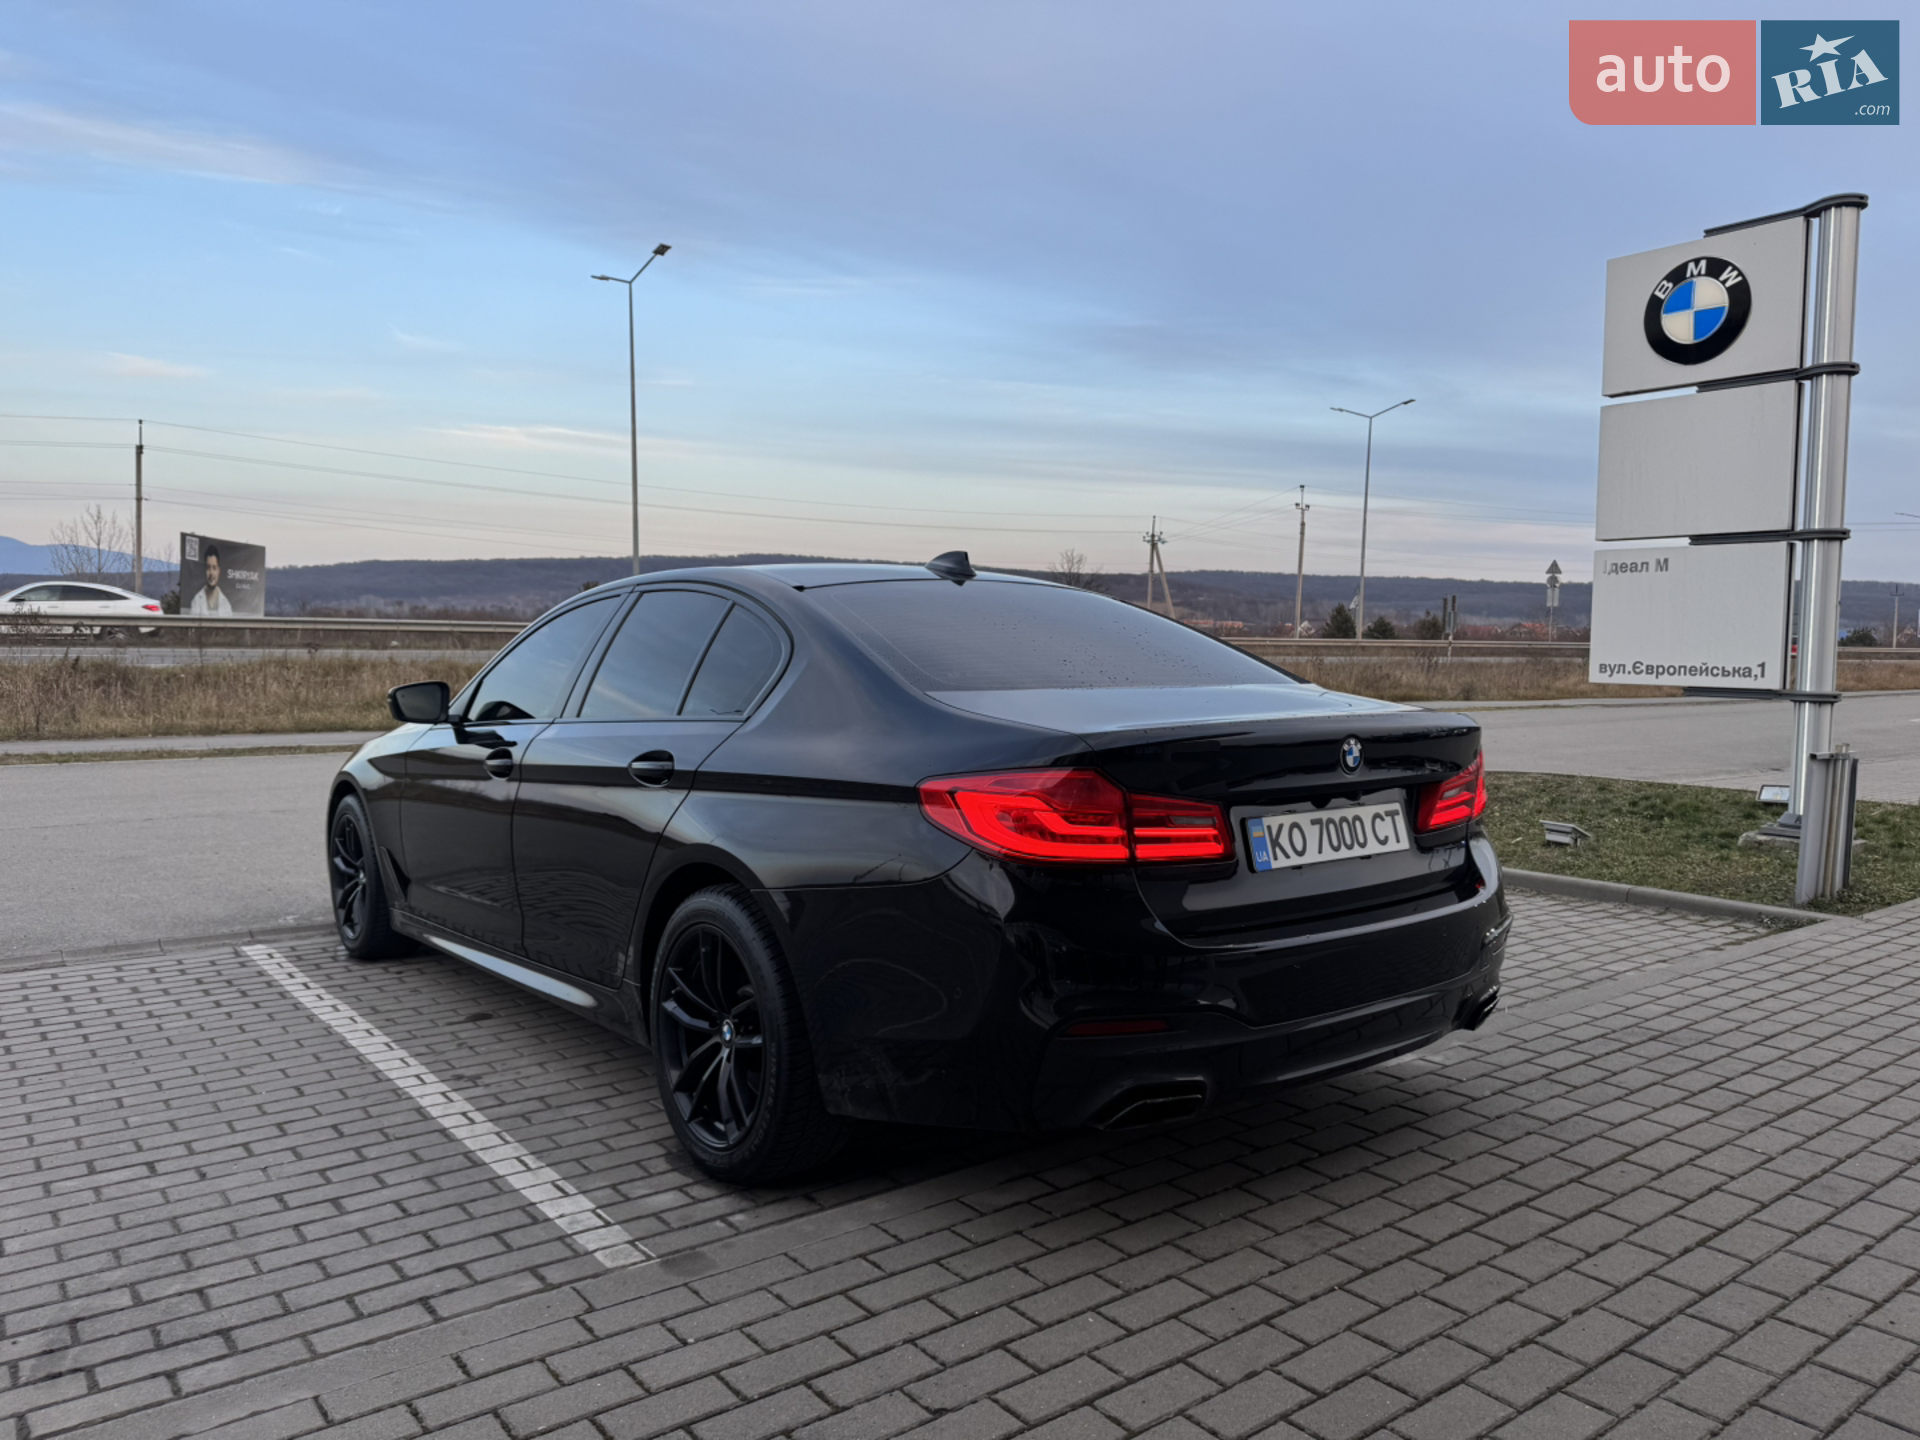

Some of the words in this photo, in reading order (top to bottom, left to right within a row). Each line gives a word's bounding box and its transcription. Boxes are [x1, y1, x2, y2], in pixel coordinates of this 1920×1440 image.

[1653, 258, 1743, 300] BMW
[1598, 660, 1767, 682] вул.Європейська,1
[1266, 820, 1308, 861] KO
[1310, 813, 1368, 855] 7000
[1370, 808, 1401, 846] CT
[1255, 851, 1270, 863] UA
